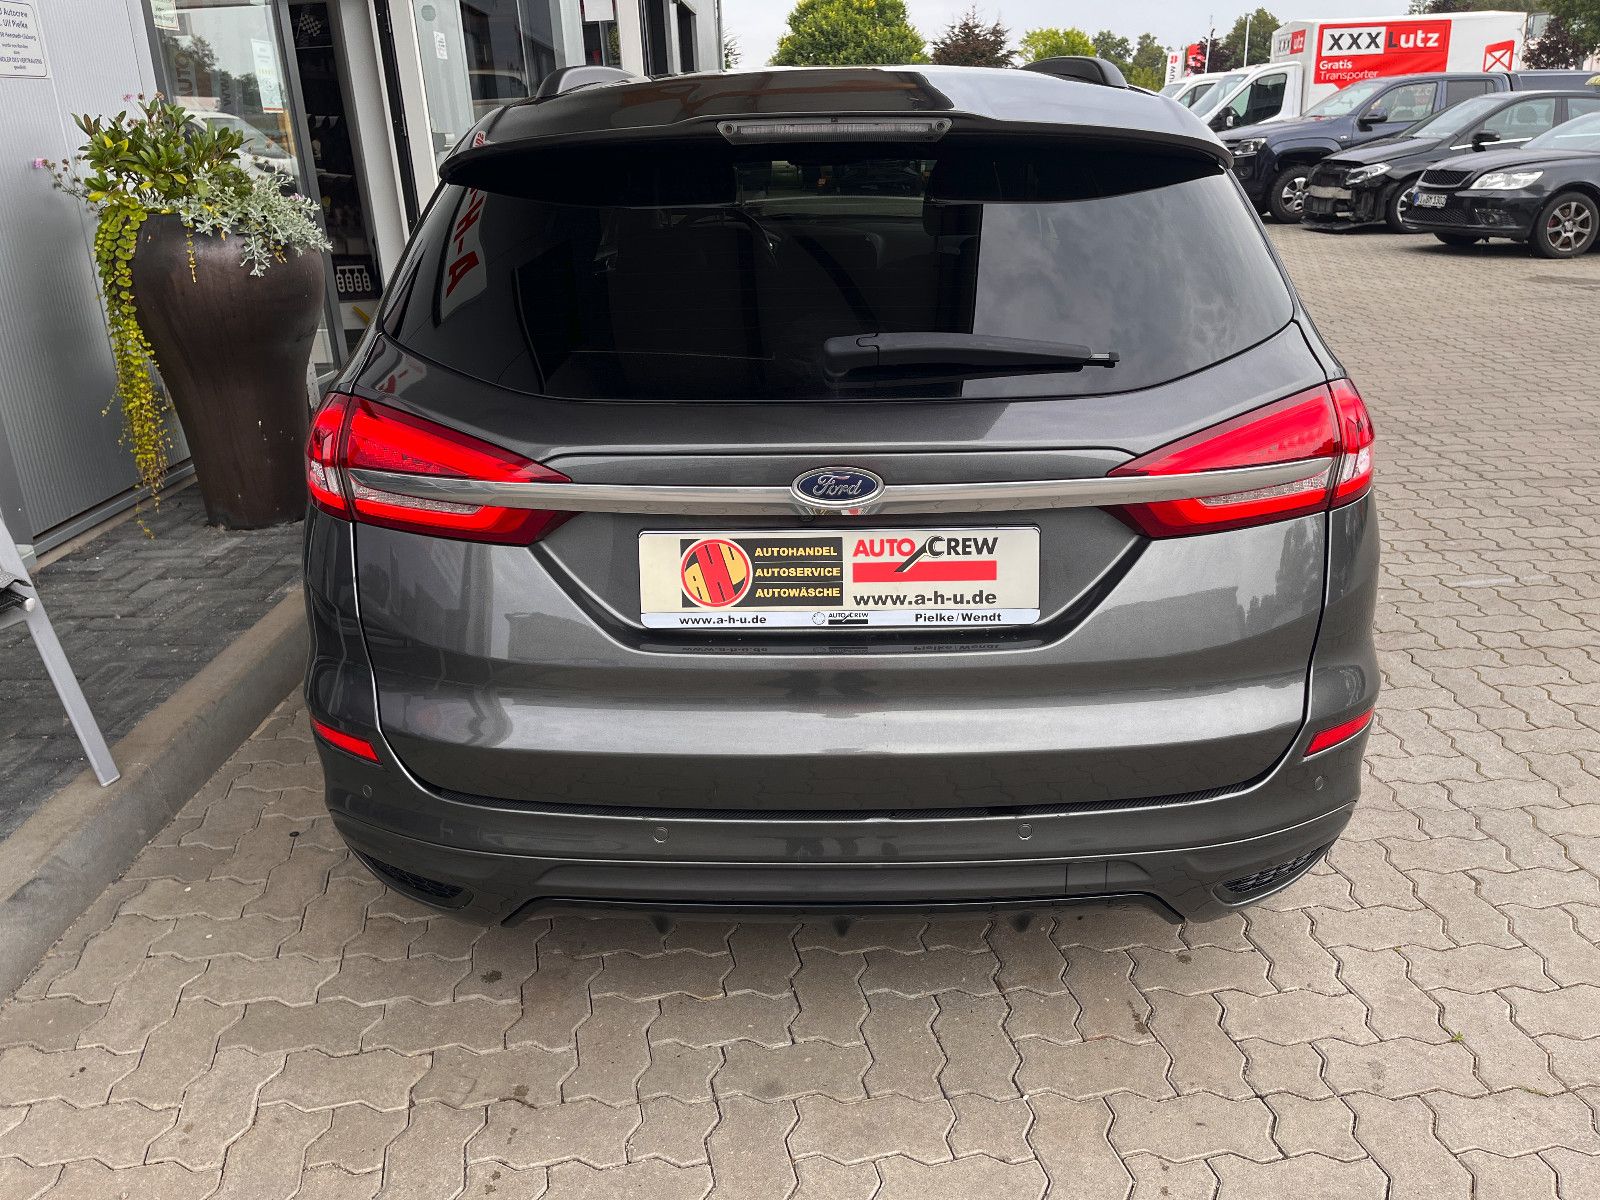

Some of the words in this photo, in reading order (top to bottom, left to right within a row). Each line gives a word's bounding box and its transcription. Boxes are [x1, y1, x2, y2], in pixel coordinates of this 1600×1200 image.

[1328, 29, 1440, 51] XXXLutz
[1320, 60, 1353, 70] Gratis
[1320, 70, 1379, 81] Transporter
[812, 474, 863, 495] Ford
[754, 546, 838, 557] AUTOHANDEL
[853, 538, 916, 557] AUTO
[926, 536, 999, 557] CREW
[755, 567, 841, 577] AUTOSERVICE
[755, 586, 841, 598] AUTOWÄSCHE
[853, 590, 997, 606] www.a-h-u.de
[679, 614, 767, 625] www.a-h-u.de
